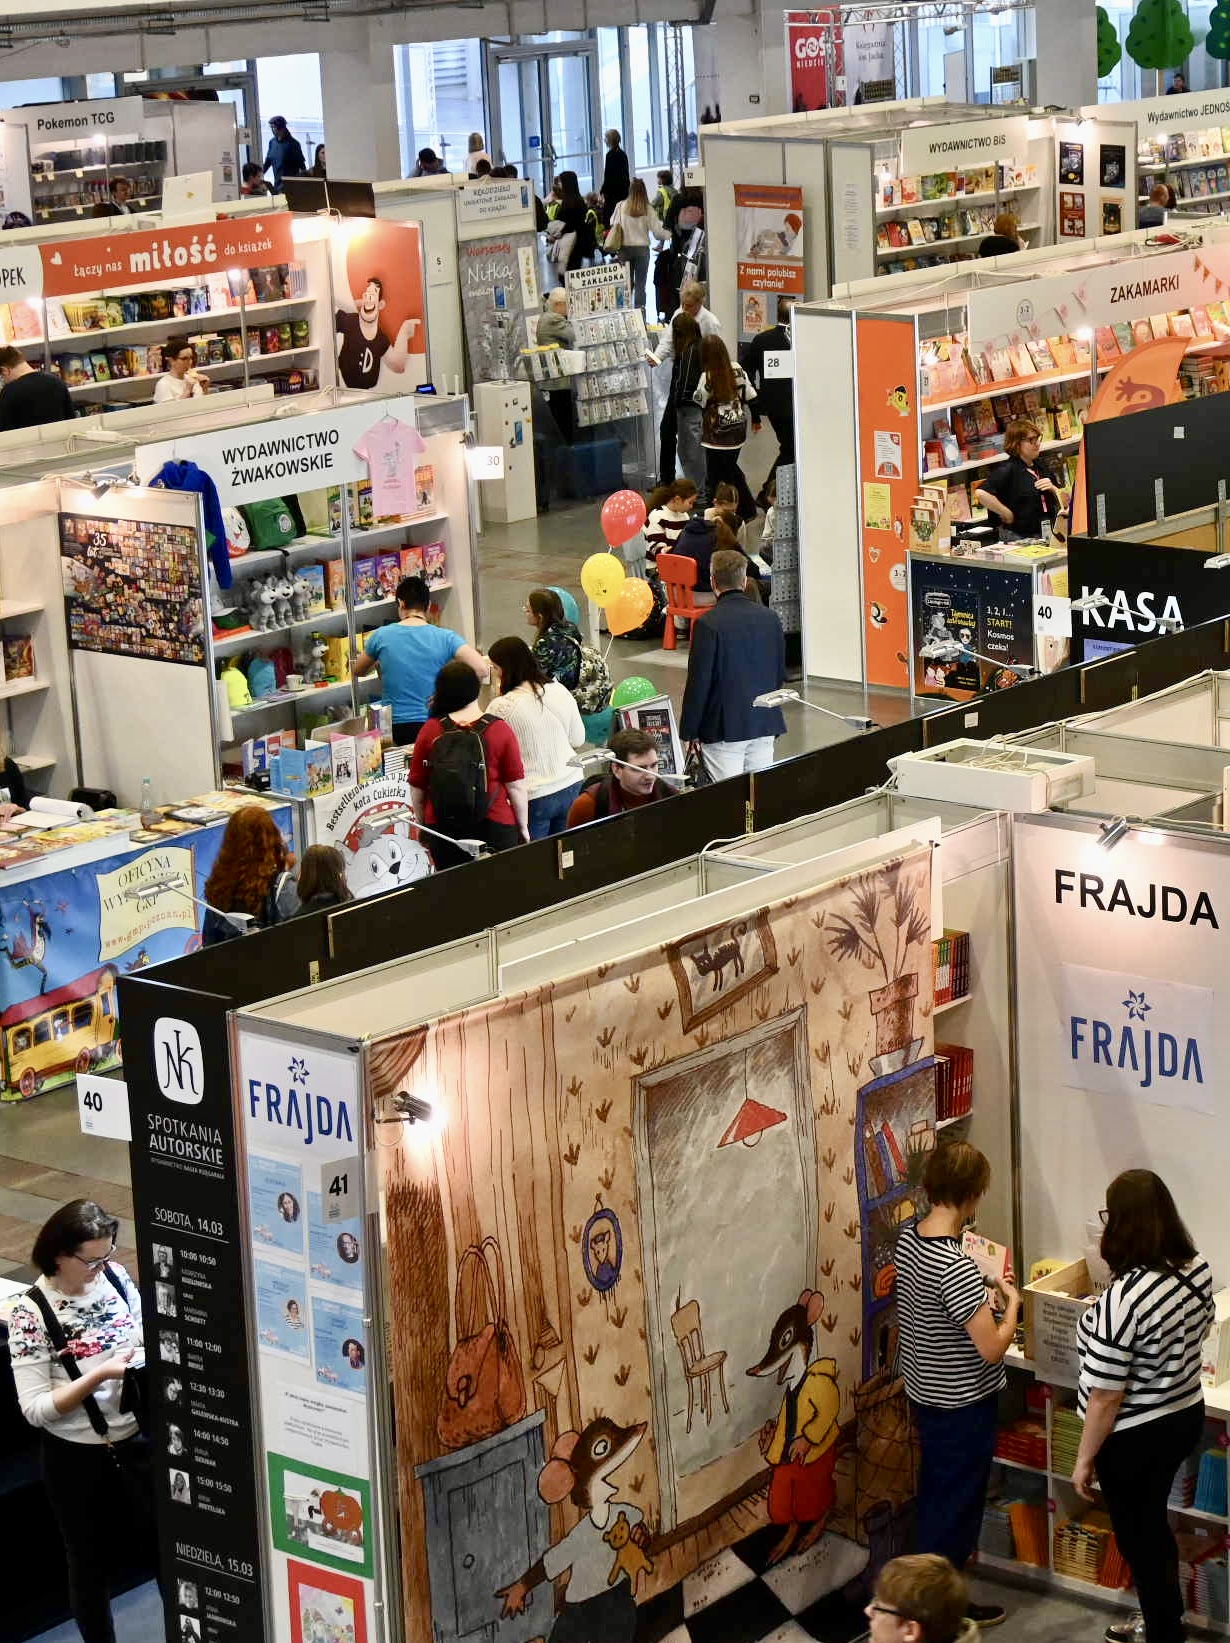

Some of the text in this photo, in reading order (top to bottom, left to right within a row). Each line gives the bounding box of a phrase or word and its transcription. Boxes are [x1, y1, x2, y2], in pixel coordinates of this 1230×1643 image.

[37, 111, 115, 131] Pokemon TCG
[1147, 106, 1198, 125] Wydawnictwo
[929, 134, 1007, 153] WYDAWNICTWO BIS
[686, 172, 694, 180] 12
[105, 260, 123, 273] nas
[129, 233, 218, 273] miłość
[223, 242, 236, 256] do
[237, 237, 273, 254] książek
[0, 266, 27, 289] PEK
[570, 264, 618, 281] RĘKODZIEŁO
[581, 273, 625, 287] ZAKŁADKA
[739, 265, 798, 280] Z nami polubisz
[752, 279, 785, 290] czytanie!
[1110, 274, 1180, 304] ZAKAMARKI
[767, 357, 780, 368] 28
[222, 428, 340, 466] WYDAWNICTWO
[231, 452, 334, 487] ŻWAKOWSKIE
[487, 454, 500, 467] 30
[93, 531, 107, 547] 35
[1037, 605, 1053, 620] 40
[1082, 585, 1185, 635] KASA
[986, 617, 1013, 629] START!
[987, 629, 1015, 641] Kosmos
[987, 641, 1009, 651] czeka!
[373, 786, 407, 801] Cukierka
[118, 855, 171, 888] OFICYNA
[1054, 868, 1220, 930] FRAJDA
[1070, 1015, 1205, 1088] FRAJDA
[83, 1090, 103, 1113] 40
[248, 1078, 354, 1145] FRAJDA
[147, 1113, 223, 1146] SPOTKANIA
[149, 1132, 225, 1166] AUTORSKIE
[328, 1173, 349, 1197] 41
[154, 1206, 223, 1236] SOBOTA, 14.03
[186, 1337, 222, 1354] 11:00 12:00
[189, 1381, 225, 1399] 12:30 13:30
[193, 1428, 229, 1446] 14:00 14:50
[196, 1475, 233, 1493] 15:00 15:50
[175, 1540, 254, 1577] NIEDZIELA, 15.03
[205, 1586, 222, 1598] 12:00
